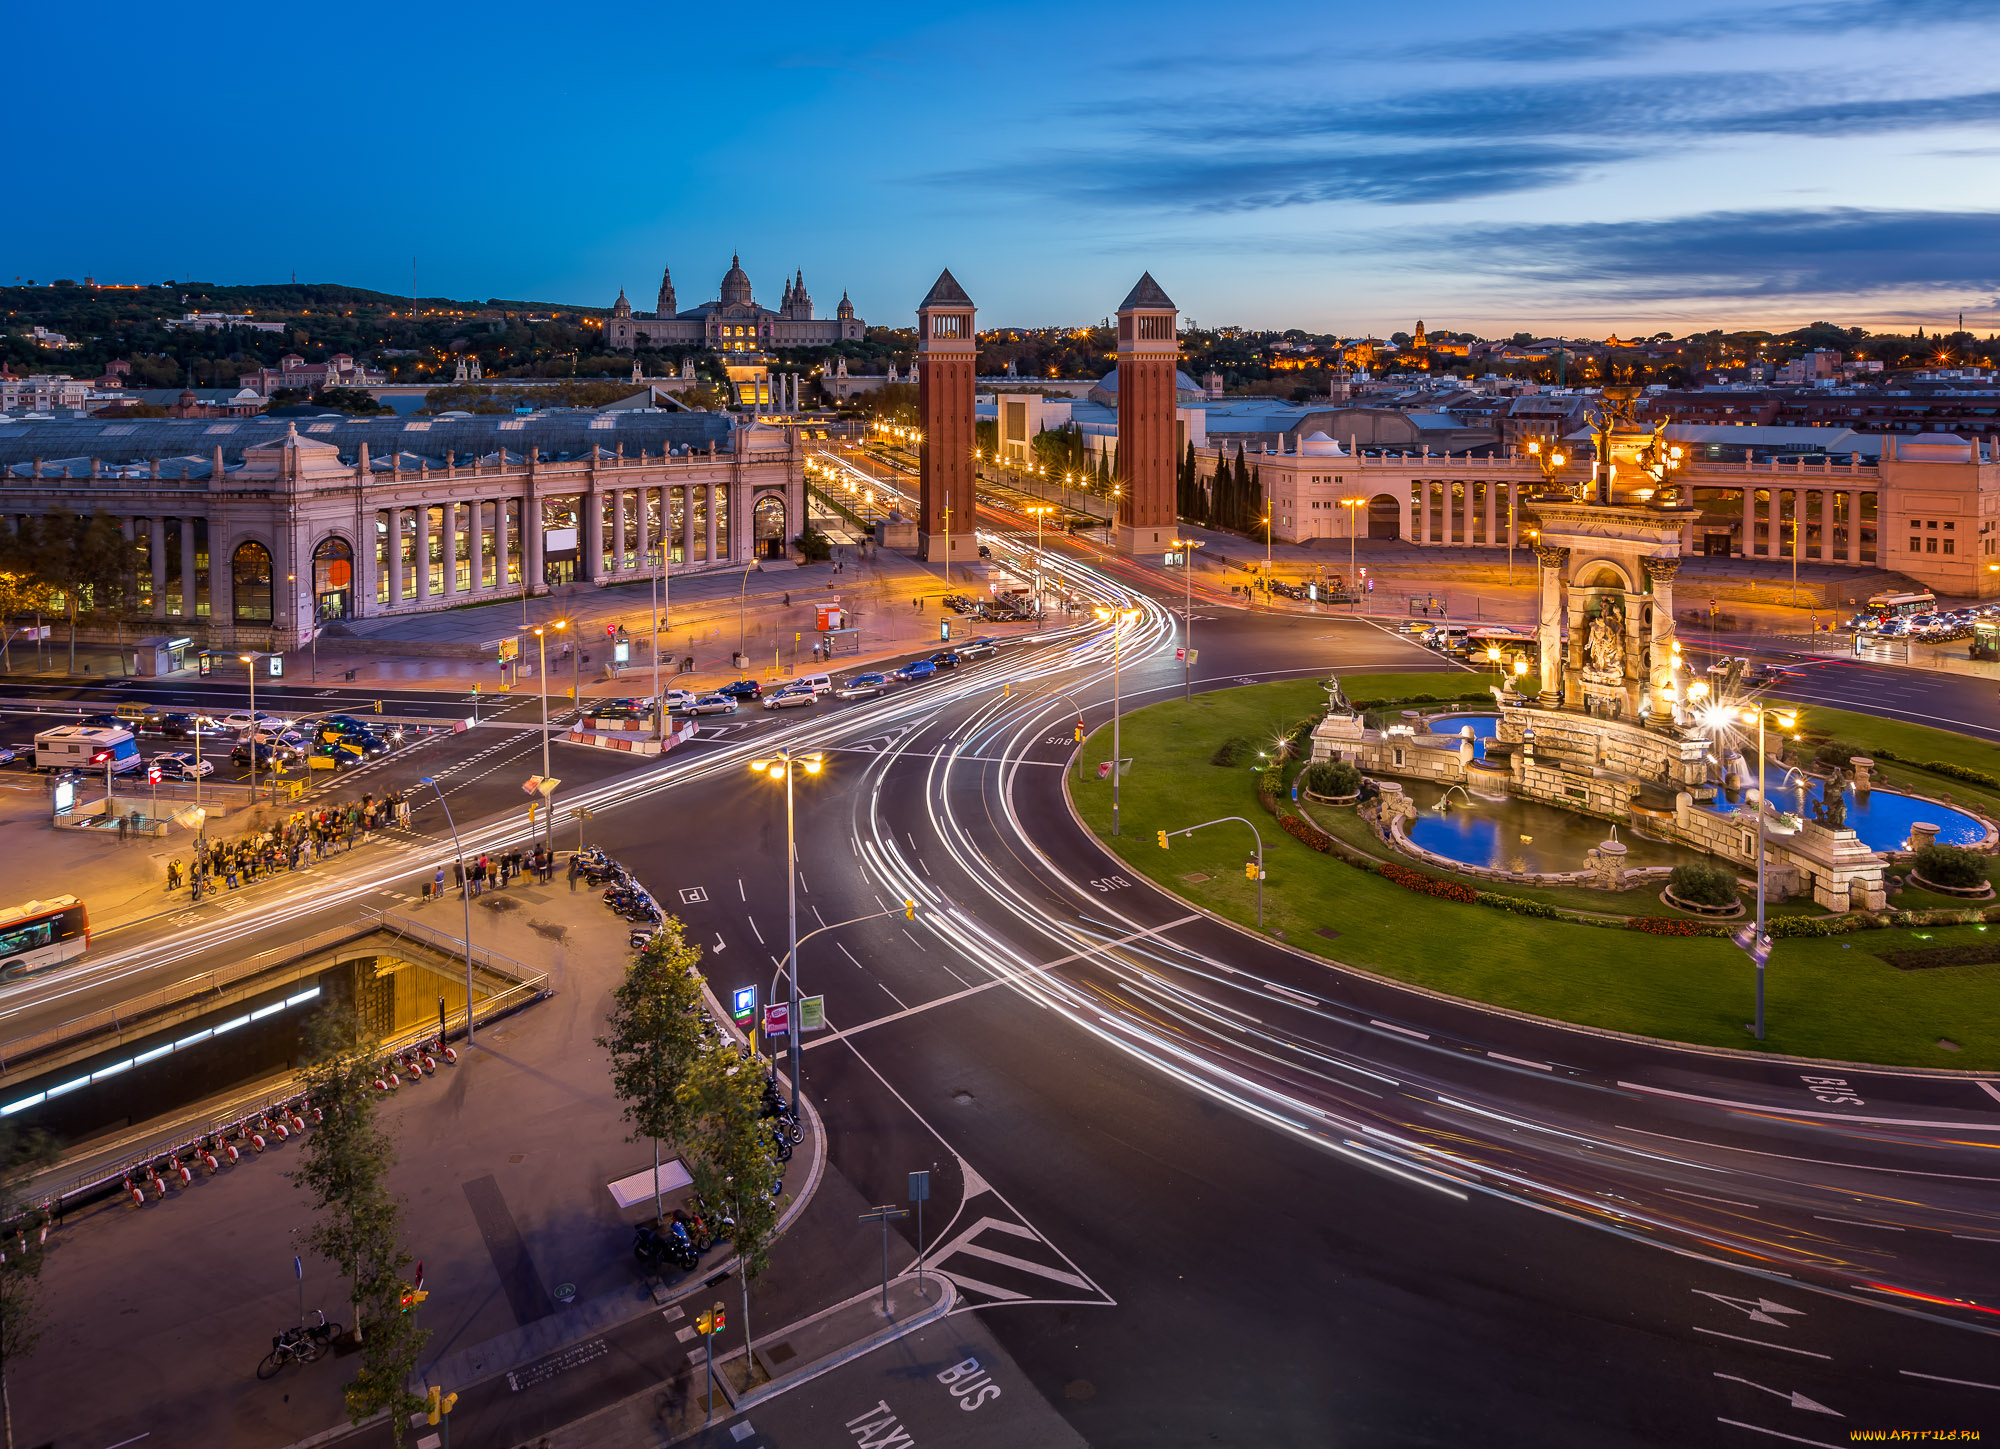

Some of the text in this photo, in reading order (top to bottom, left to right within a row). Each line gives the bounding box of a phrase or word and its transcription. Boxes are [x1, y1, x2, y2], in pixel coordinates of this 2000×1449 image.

[1045, 737, 1074, 746] BUS
[1090, 876, 1132, 891] BUS
[1800, 1075, 1865, 1106] BUS
[936, 1356, 1001, 1412] BUS
